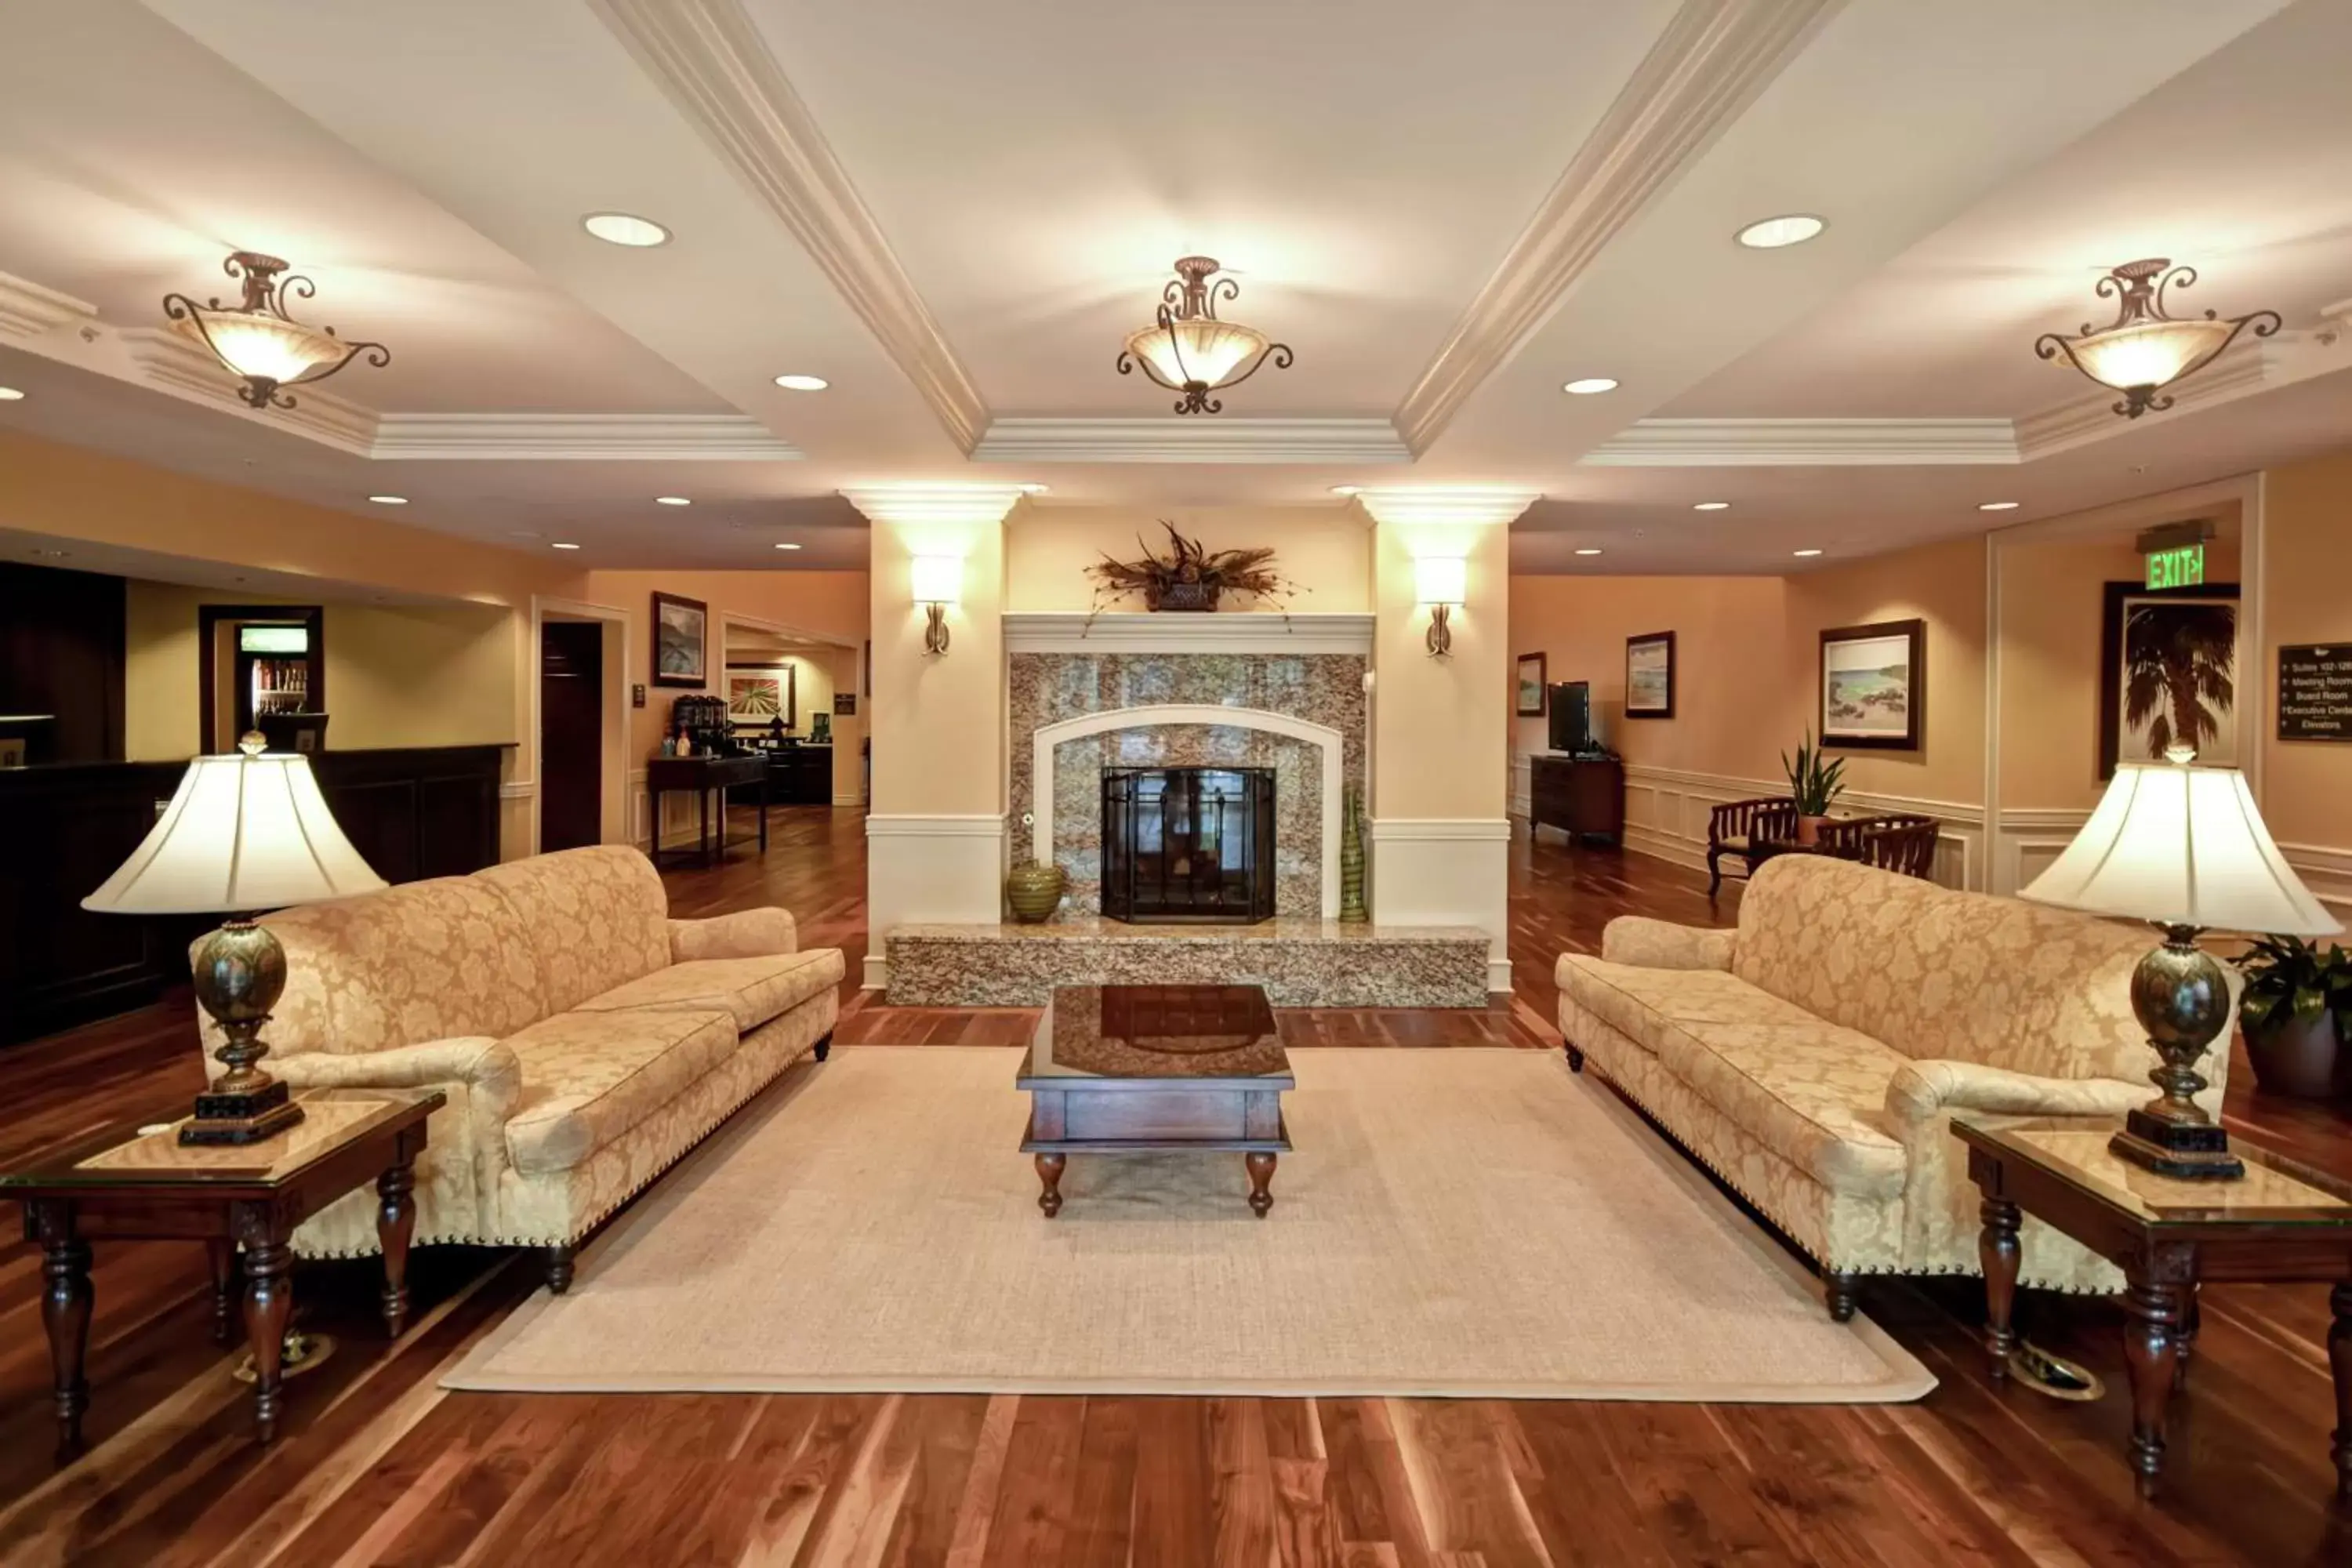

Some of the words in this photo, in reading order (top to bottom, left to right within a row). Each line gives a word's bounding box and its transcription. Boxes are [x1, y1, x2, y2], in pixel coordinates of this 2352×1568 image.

[2150, 550, 2192, 587] EXIT
[2292, 677, 2325, 687] Meeting
[2296, 691, 2321, 700] Board
[2322, 691, 2348, 700] Room
[2287, 706, 2326, 714] Executive
[2301, 720, 2341, 729] Elevators
